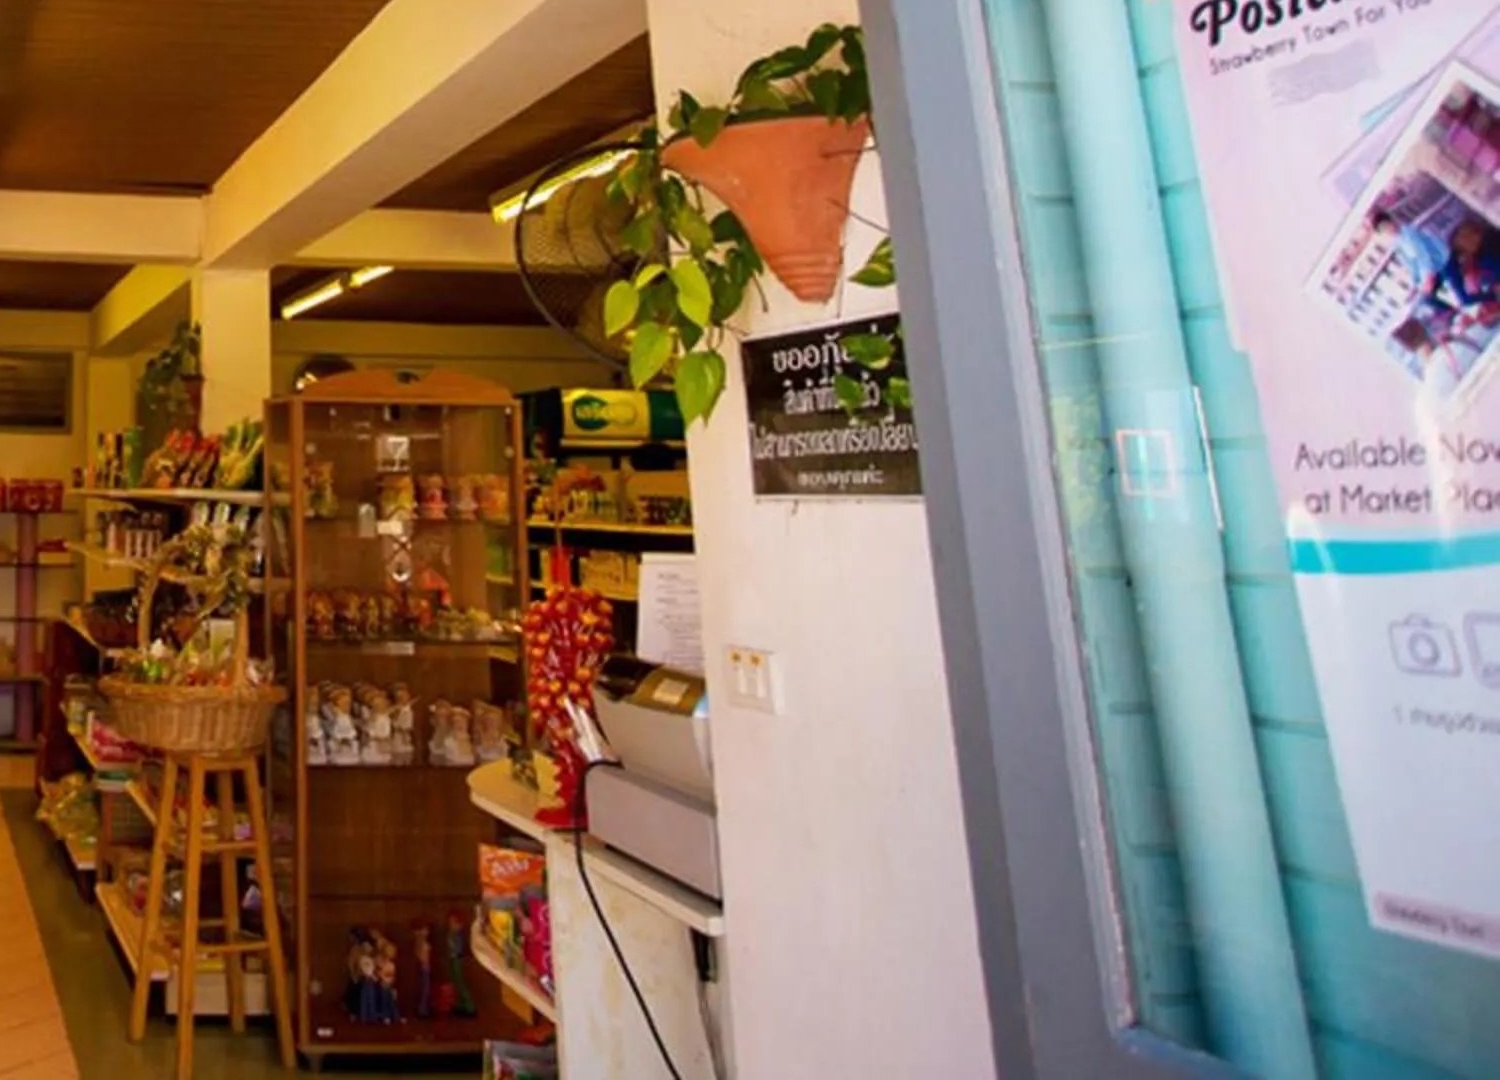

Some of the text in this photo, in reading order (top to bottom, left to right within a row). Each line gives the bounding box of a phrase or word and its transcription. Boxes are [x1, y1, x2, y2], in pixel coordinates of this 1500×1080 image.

[1209, 37, 1297, 76] Strawberry
[1301, 19, 1350, 44] Town
[1353, 6, 1386, 26] For
[1294, 436, 1427, 472] Available
[1304, 489, 1331, 515] at
[1339, 483, 1432, 515] Market
